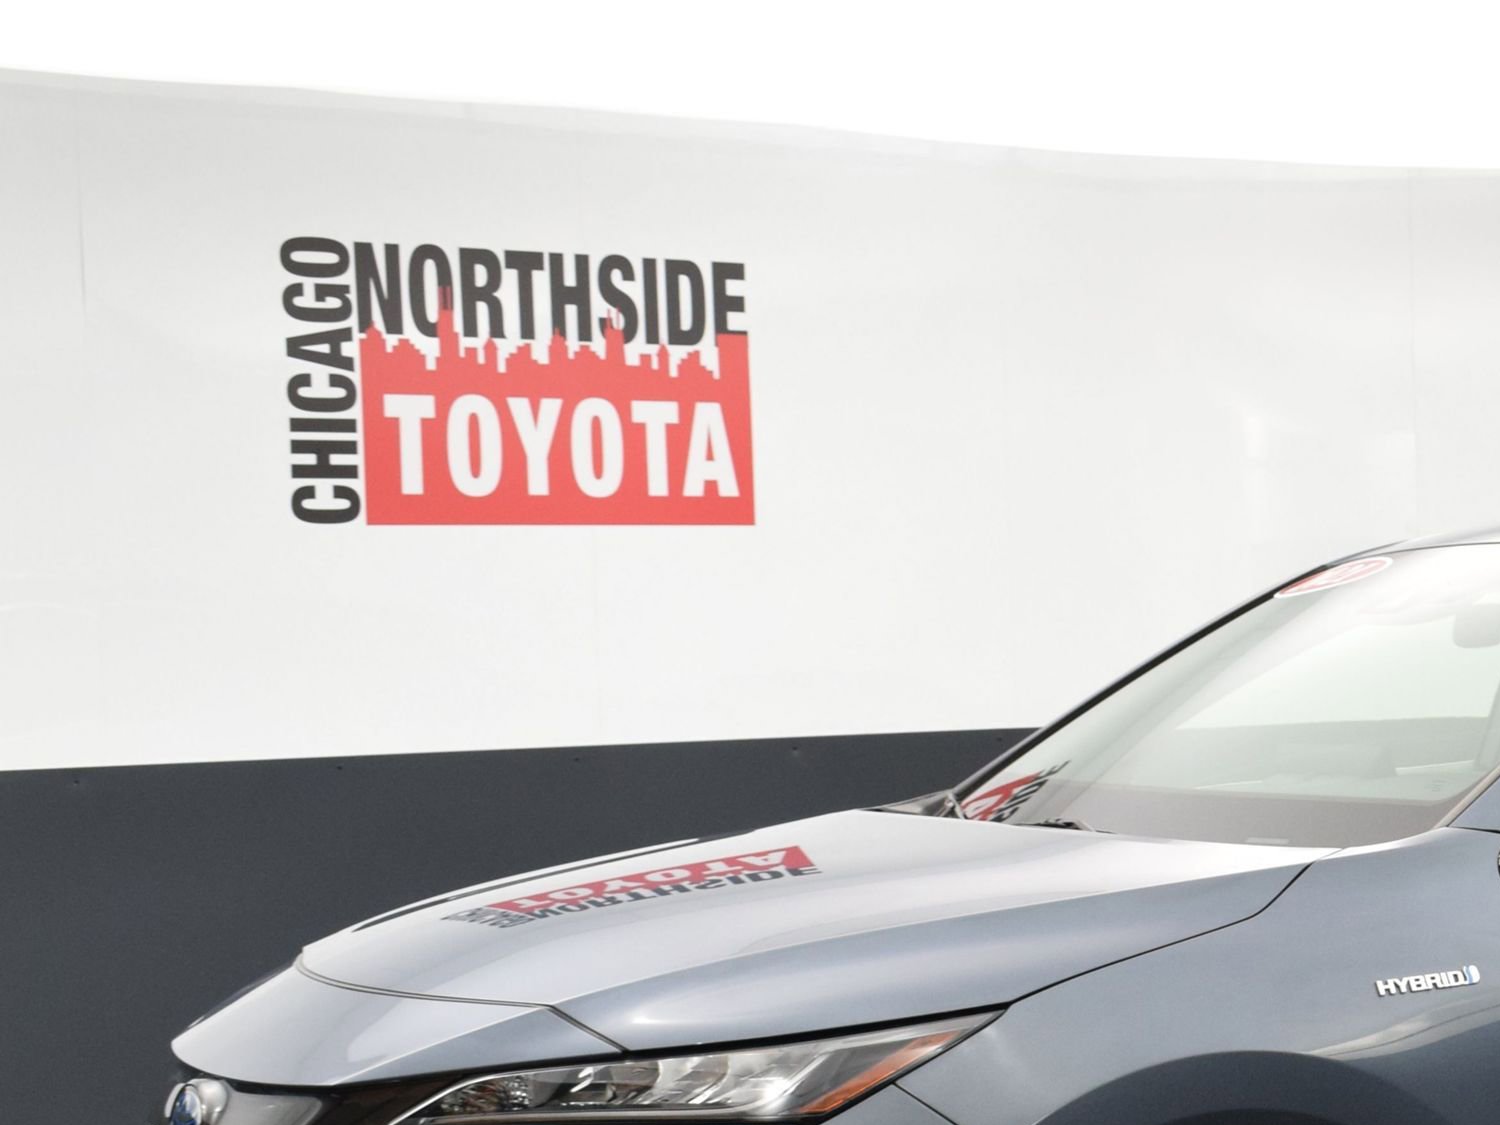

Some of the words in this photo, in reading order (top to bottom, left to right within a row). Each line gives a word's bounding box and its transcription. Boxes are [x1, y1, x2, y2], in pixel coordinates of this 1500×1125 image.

[353, 241, 748, 347] NORTHSIDE
[279, 236, 361, 525] CHICAGO
[382, 393, 741, 499] TOYOTA
[1375, 970, 1466, 997] HYBRID
